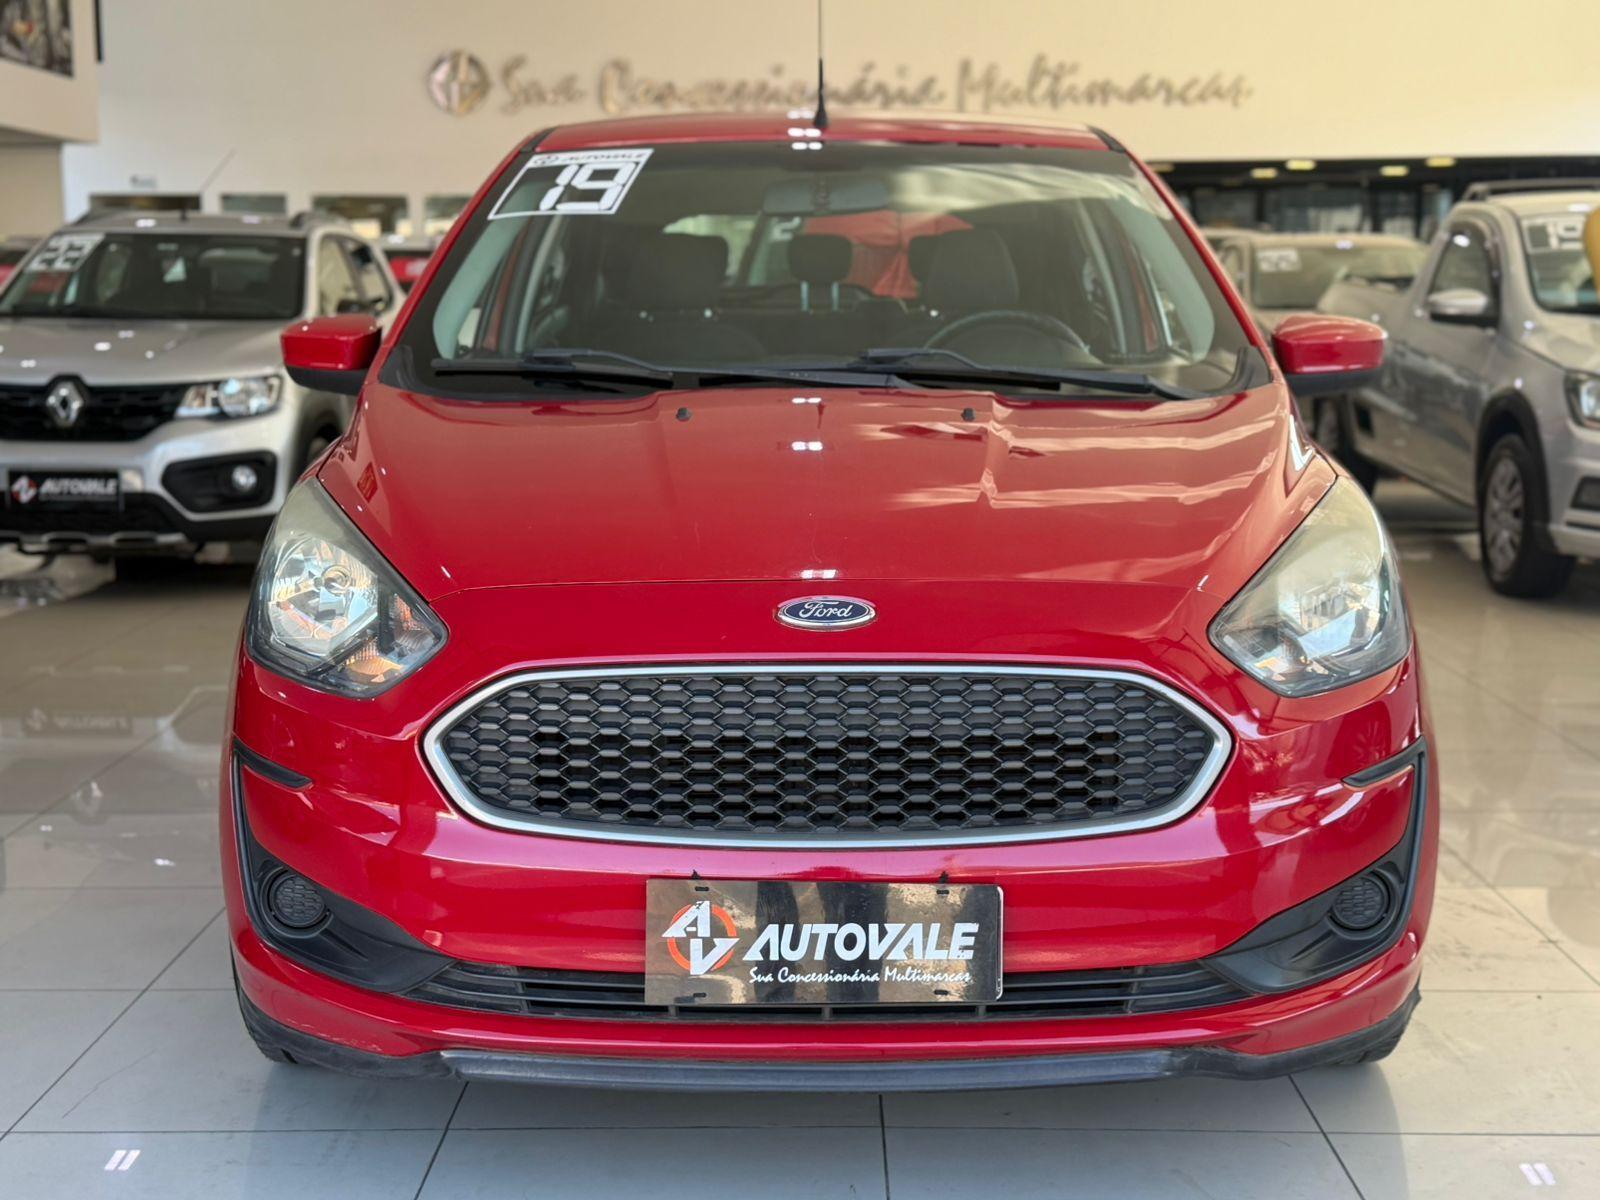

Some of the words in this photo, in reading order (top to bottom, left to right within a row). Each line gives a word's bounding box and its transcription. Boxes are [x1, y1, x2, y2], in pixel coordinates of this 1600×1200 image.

[539, 161, 637, 211] 19
[798, 600, 854, 618] Ford
[742, 922, 979, 961] AUTOVALE
[749, 966, 774, 984] Sua
[777, 966, 880, 984] Concessionária
[884, 966, 972, 985] Multimarcas
